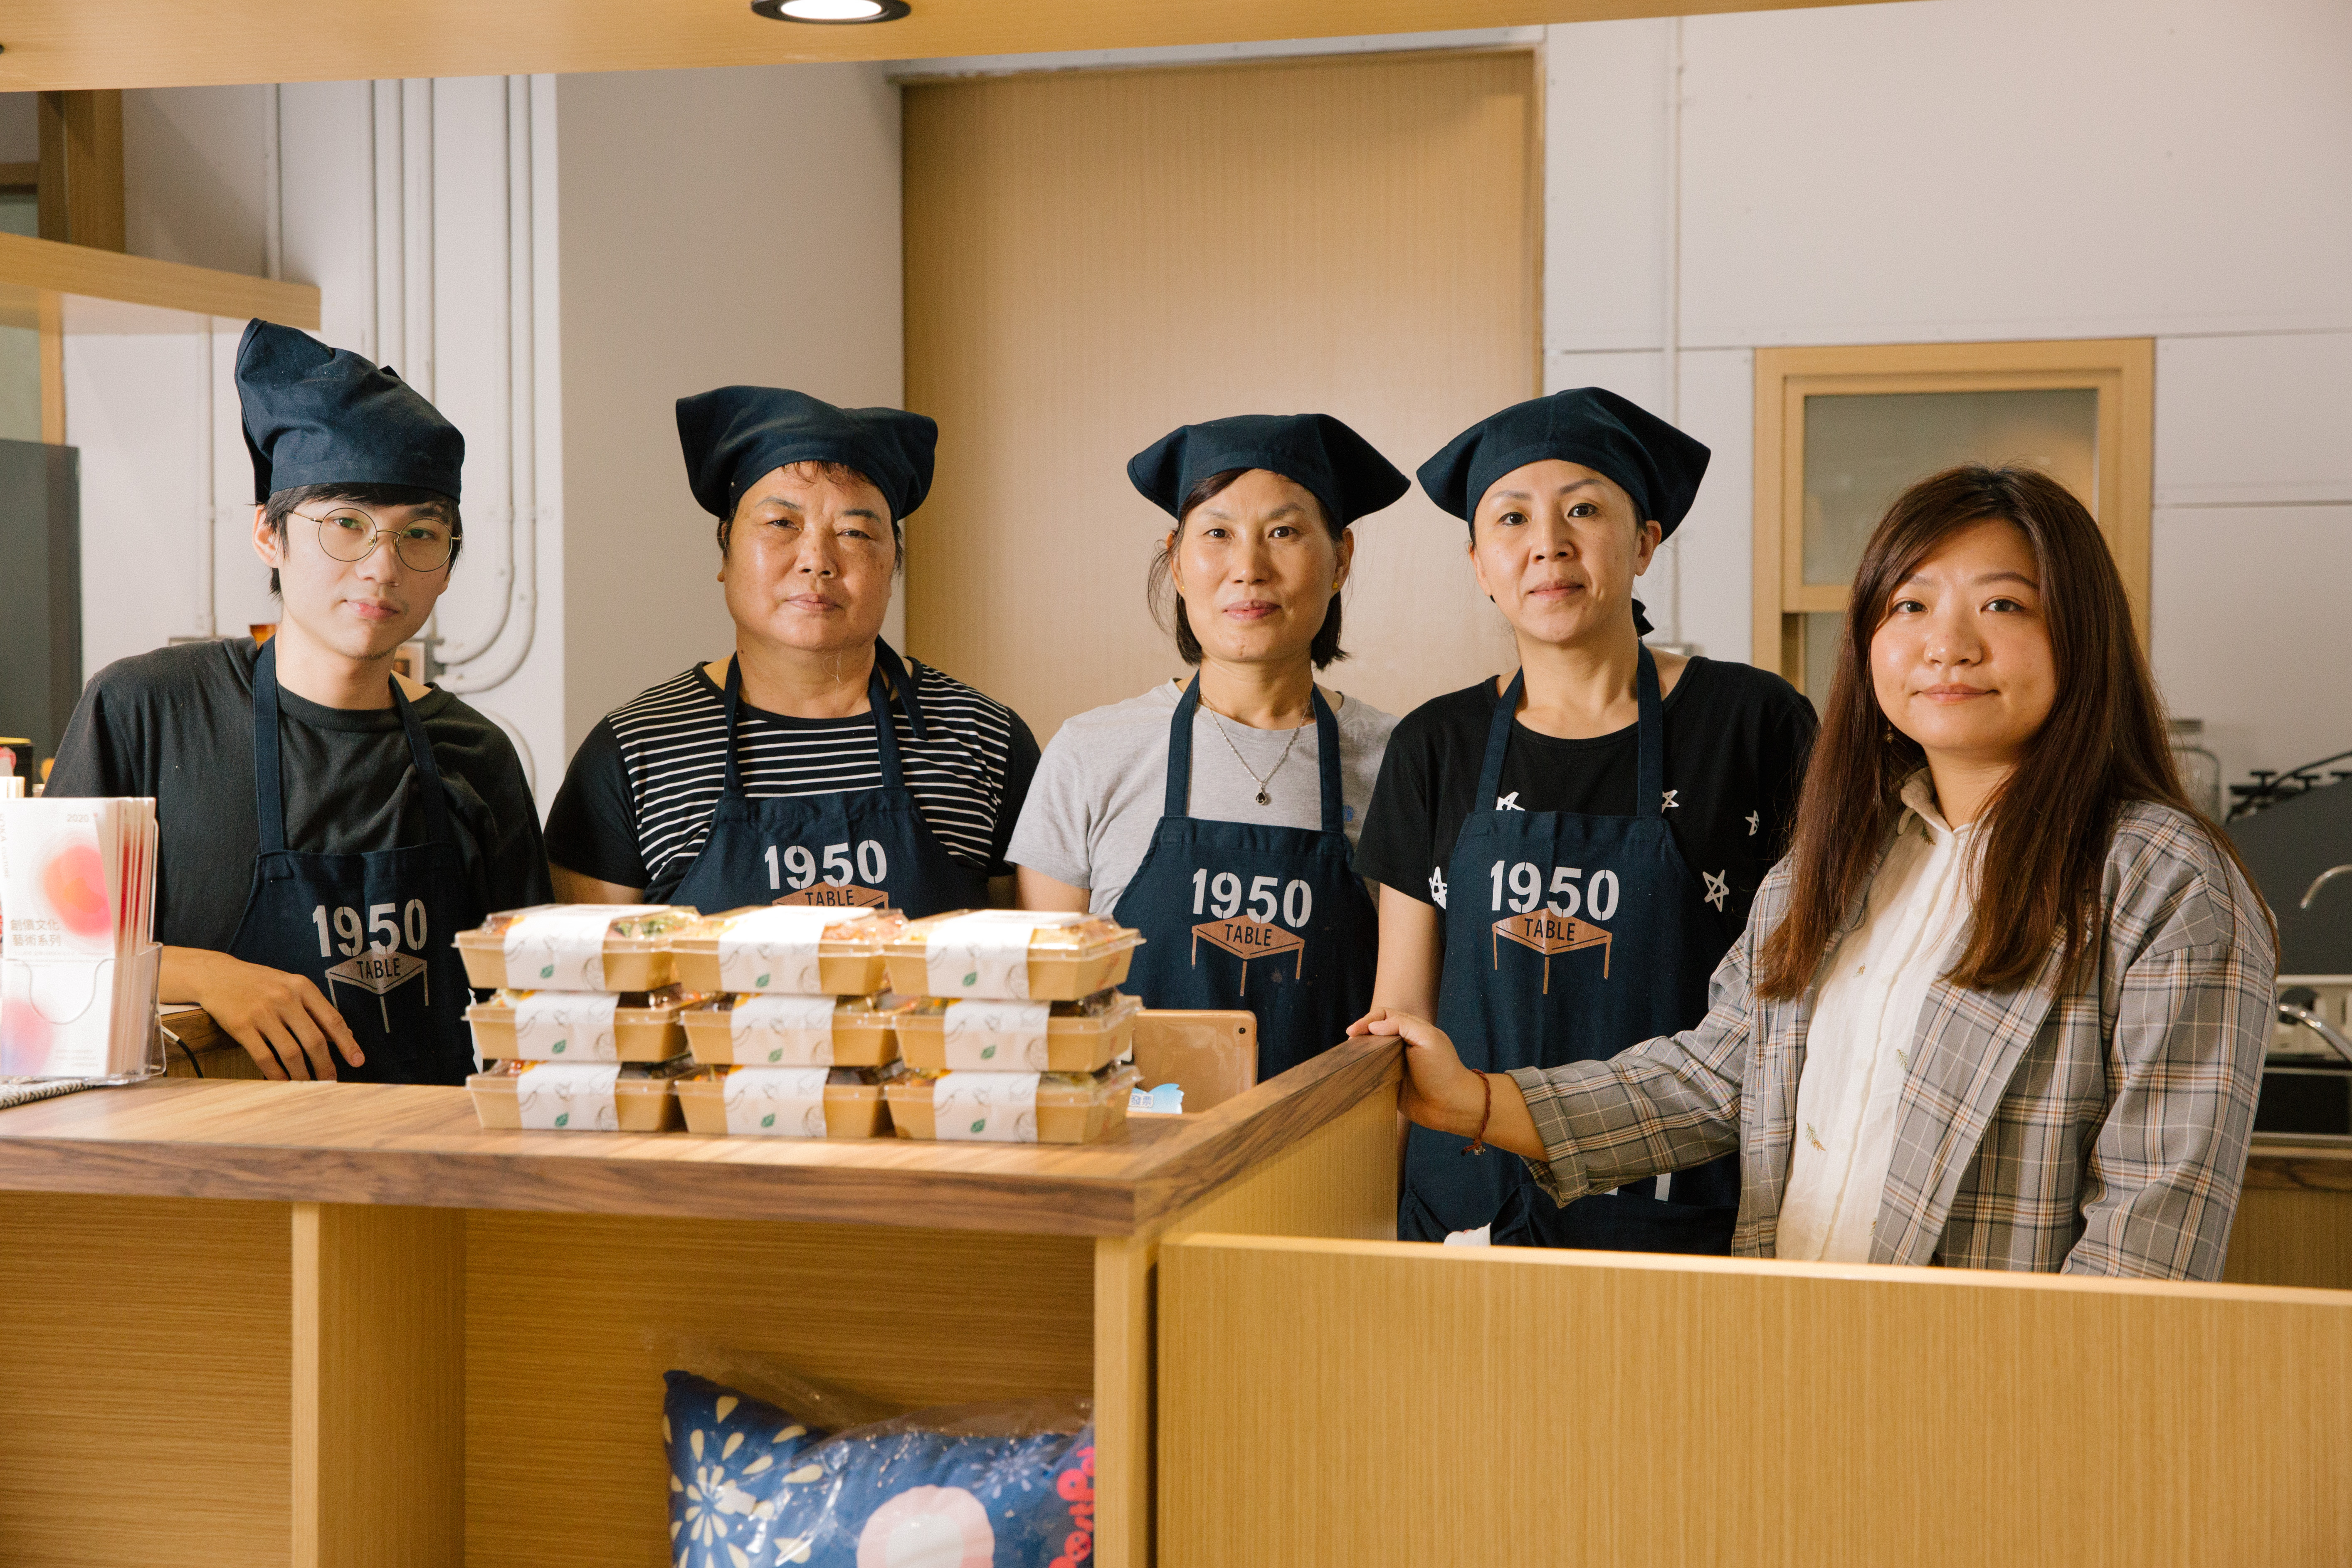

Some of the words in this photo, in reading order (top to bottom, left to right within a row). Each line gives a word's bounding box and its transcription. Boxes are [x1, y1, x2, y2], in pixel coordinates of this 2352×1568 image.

[67, 814, 89, 822] 2020
[765, 840, 887, 889] 1950
[805, 889, 854, 906] TABLE
[1192, 868, 1312, 928] 1950
[1491, 860, 1619, 921] 1950
[10, 919, 60, 931] 創價文化
[312, 899, 427, 957] 1950
[1225, 924, 1272, 946] TABLE
[1524, 918, 1575, 941] TABLE
[12, 934, 61, 946] 藝術系列
[356, 958, 400, 979] TABLE
[1131, 1095, 1152, 1106] 發票
